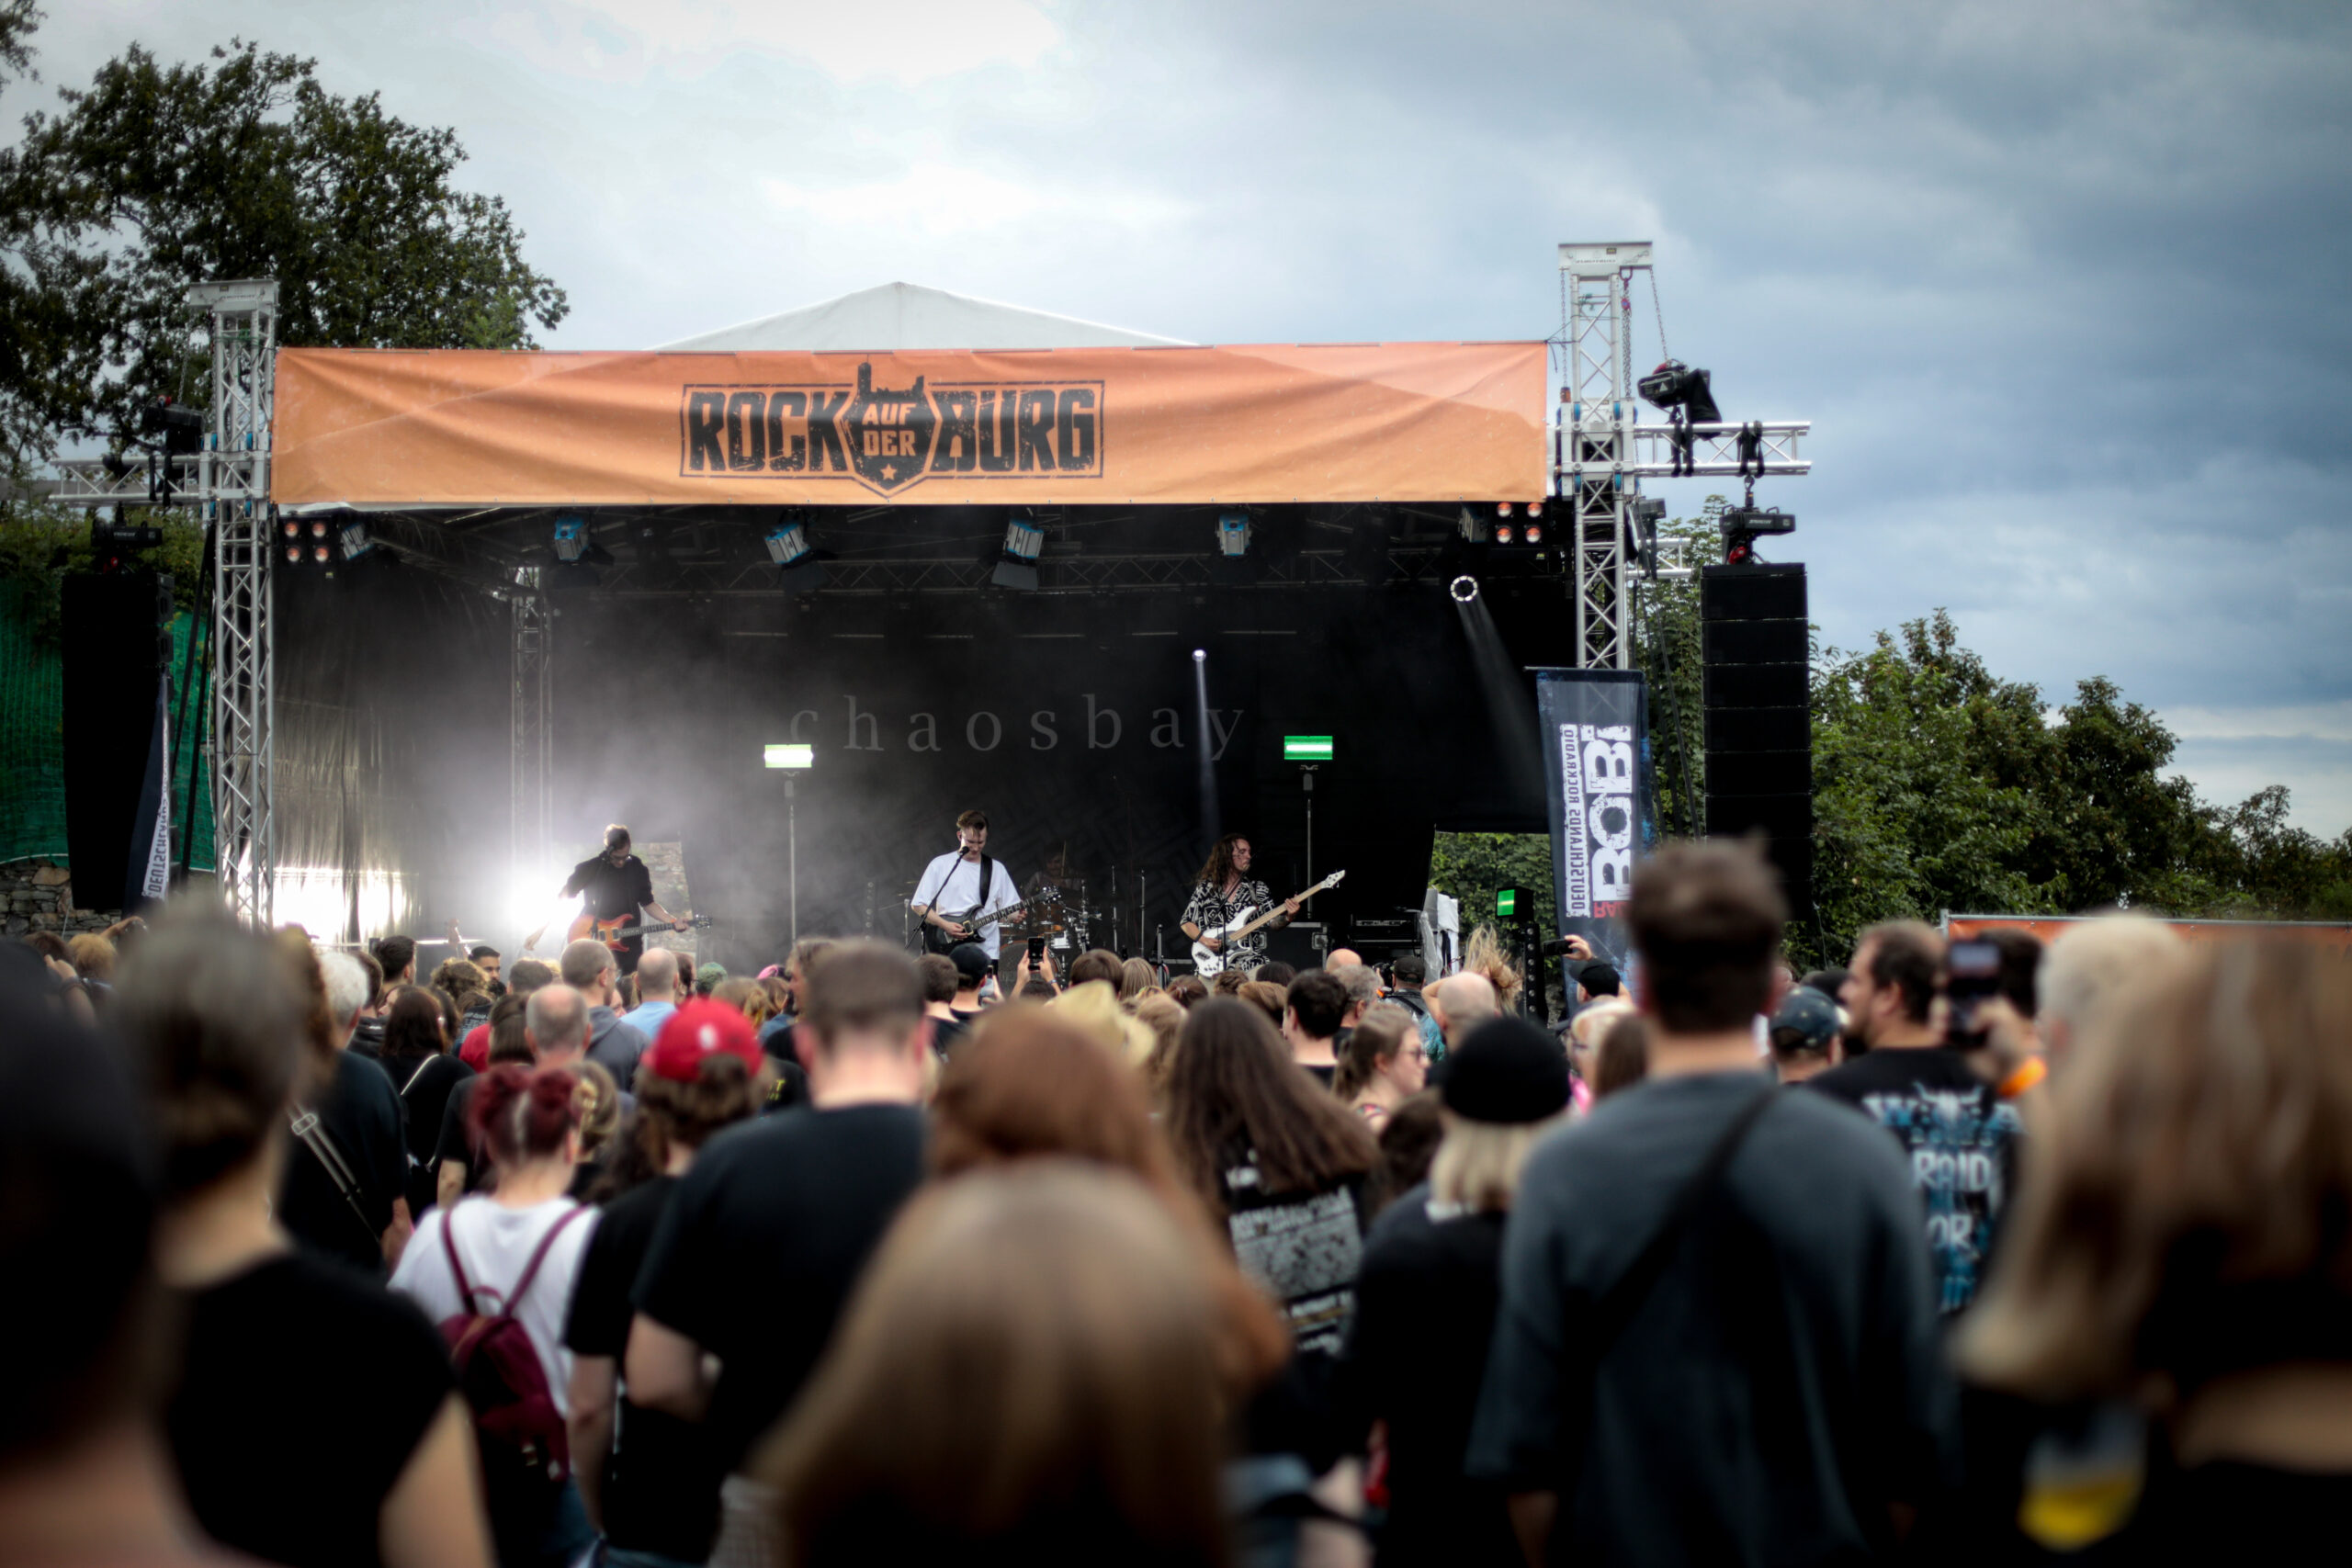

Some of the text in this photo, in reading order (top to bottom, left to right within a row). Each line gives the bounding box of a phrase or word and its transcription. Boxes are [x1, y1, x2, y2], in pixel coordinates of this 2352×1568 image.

[688, 390, 852, 472] ROCK
[862, 402, 917, 426] AUF
[862, 429, 917, 457] DER
[929, 389, 1096, 472] BURG
[789, 694, 1245, 761] chaosbay
